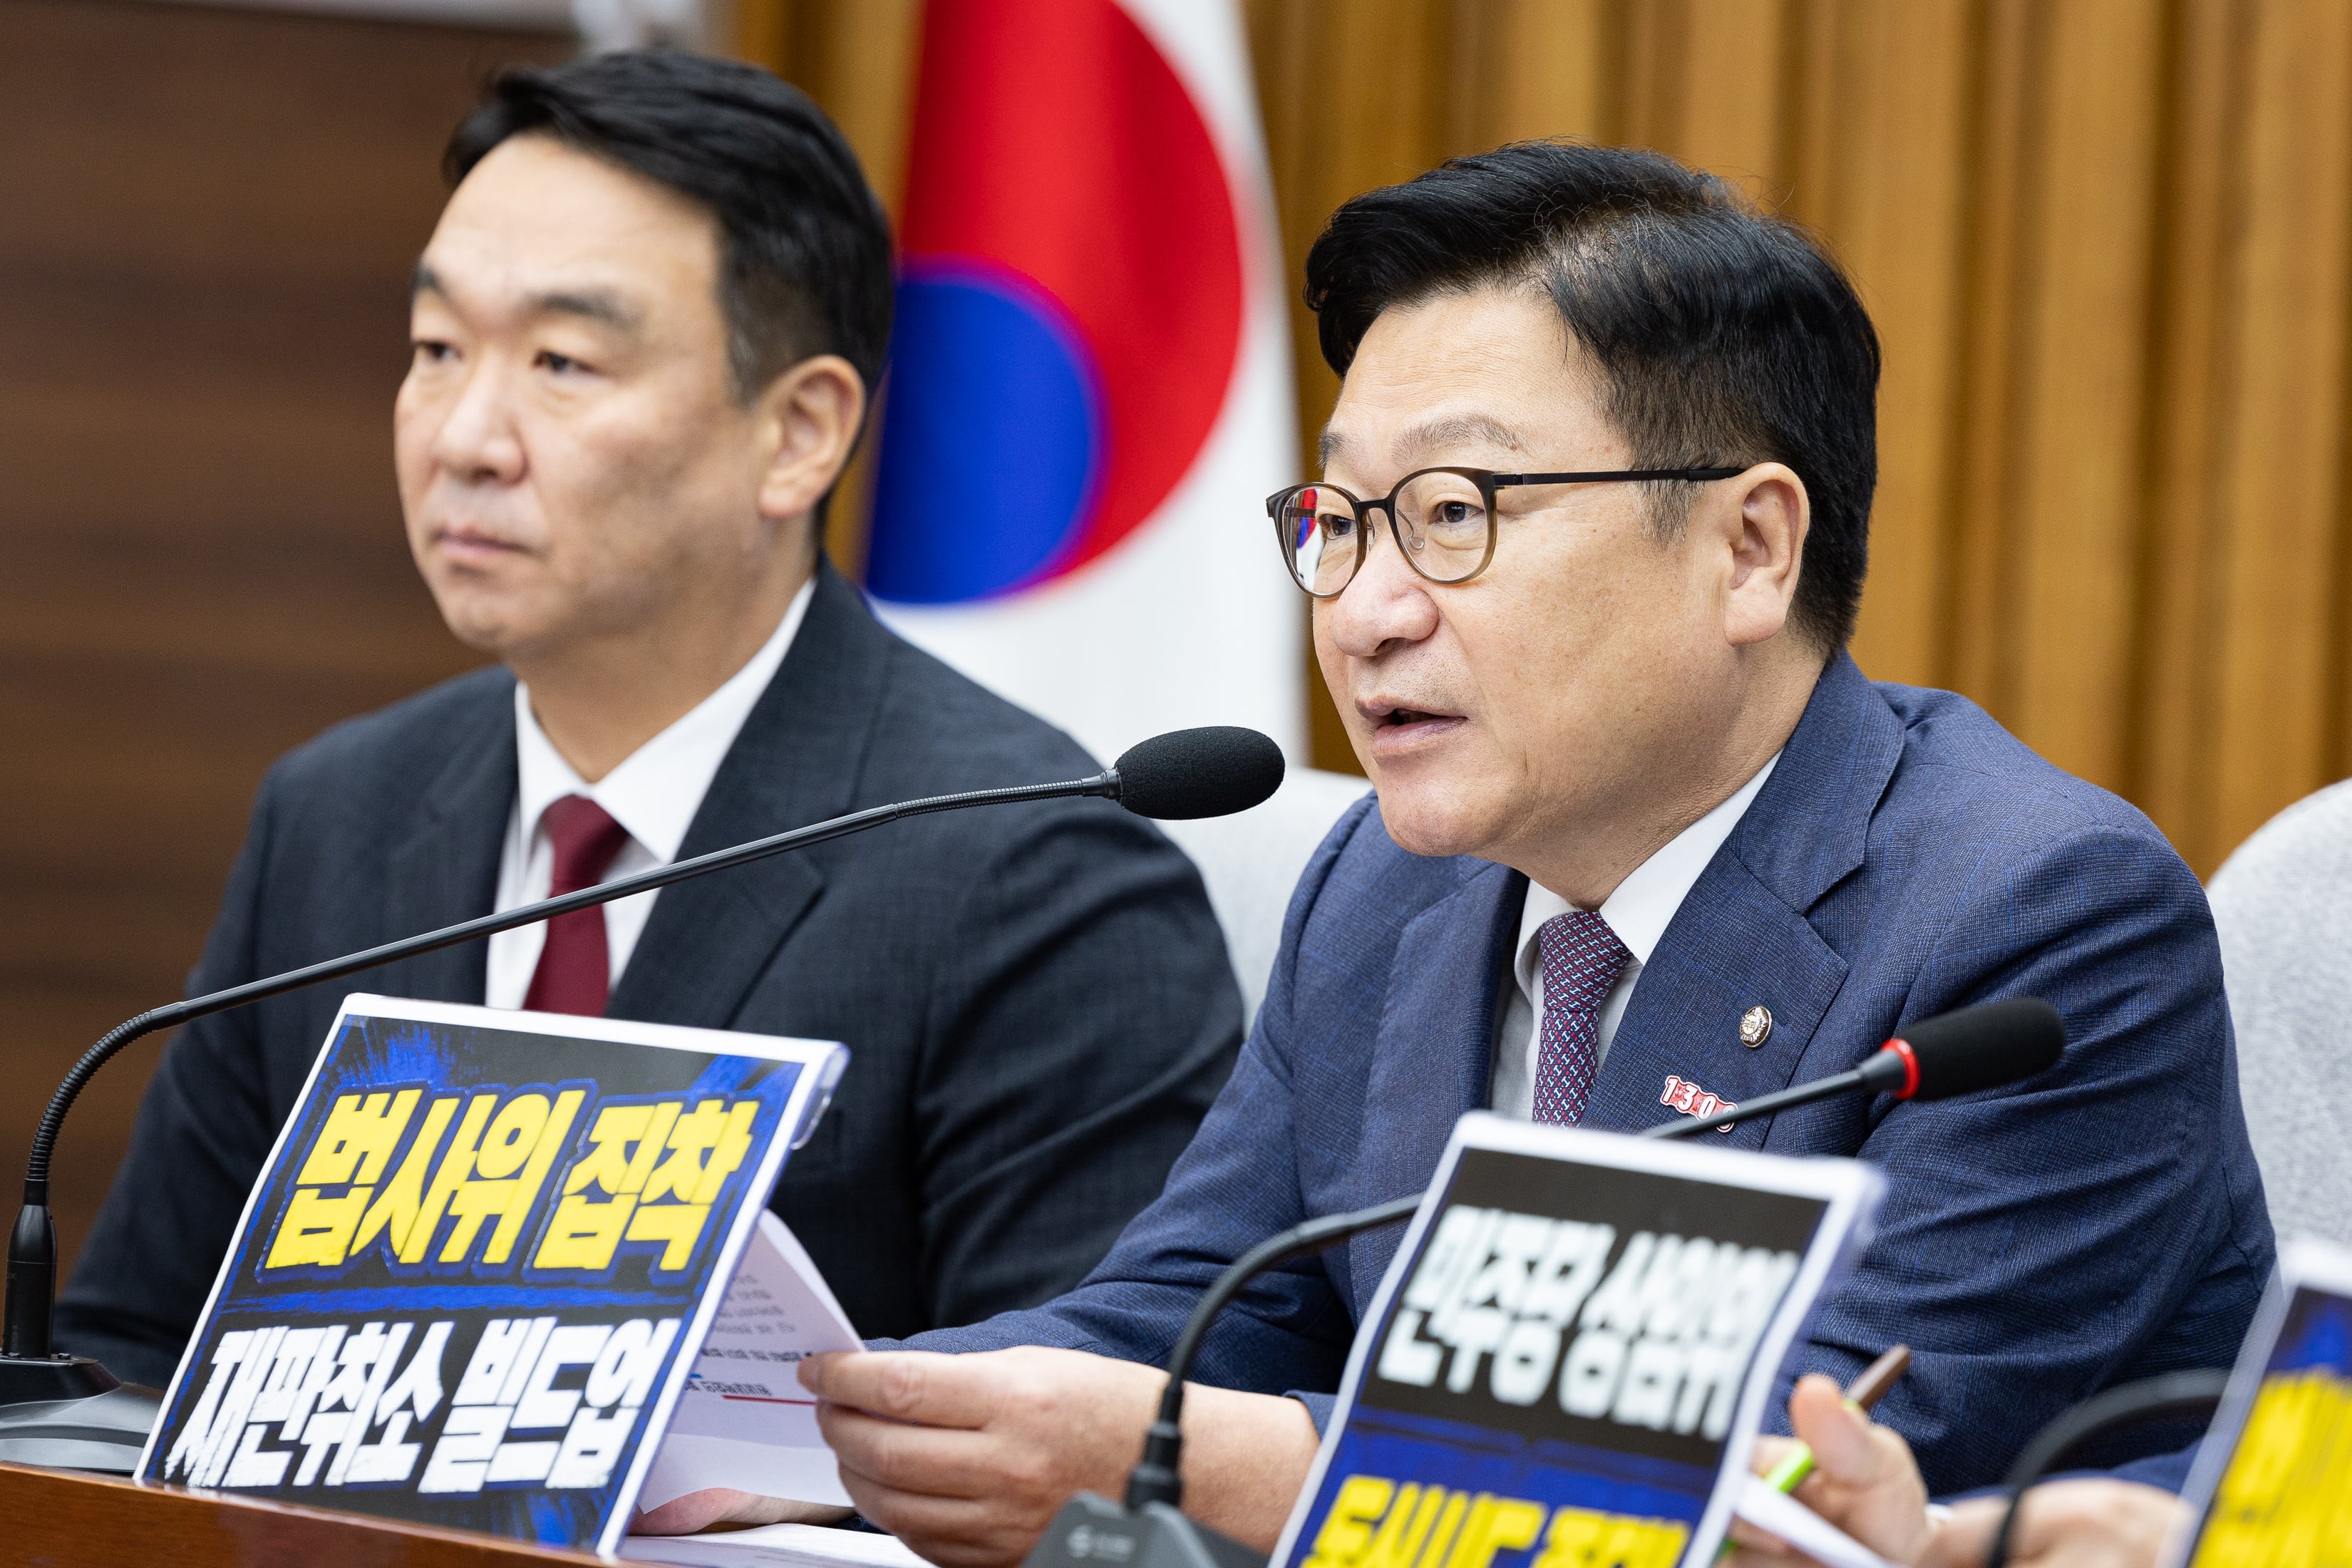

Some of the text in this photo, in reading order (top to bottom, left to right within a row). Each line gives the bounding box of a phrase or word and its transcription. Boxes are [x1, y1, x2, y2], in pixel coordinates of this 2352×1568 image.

[265, 1088, 760, 1271] 법사위 집착
[164, 1316, 681, 1493] 재판취소 빌드업
[1376, 1203, 1800, 1441] 민주당 상임위
